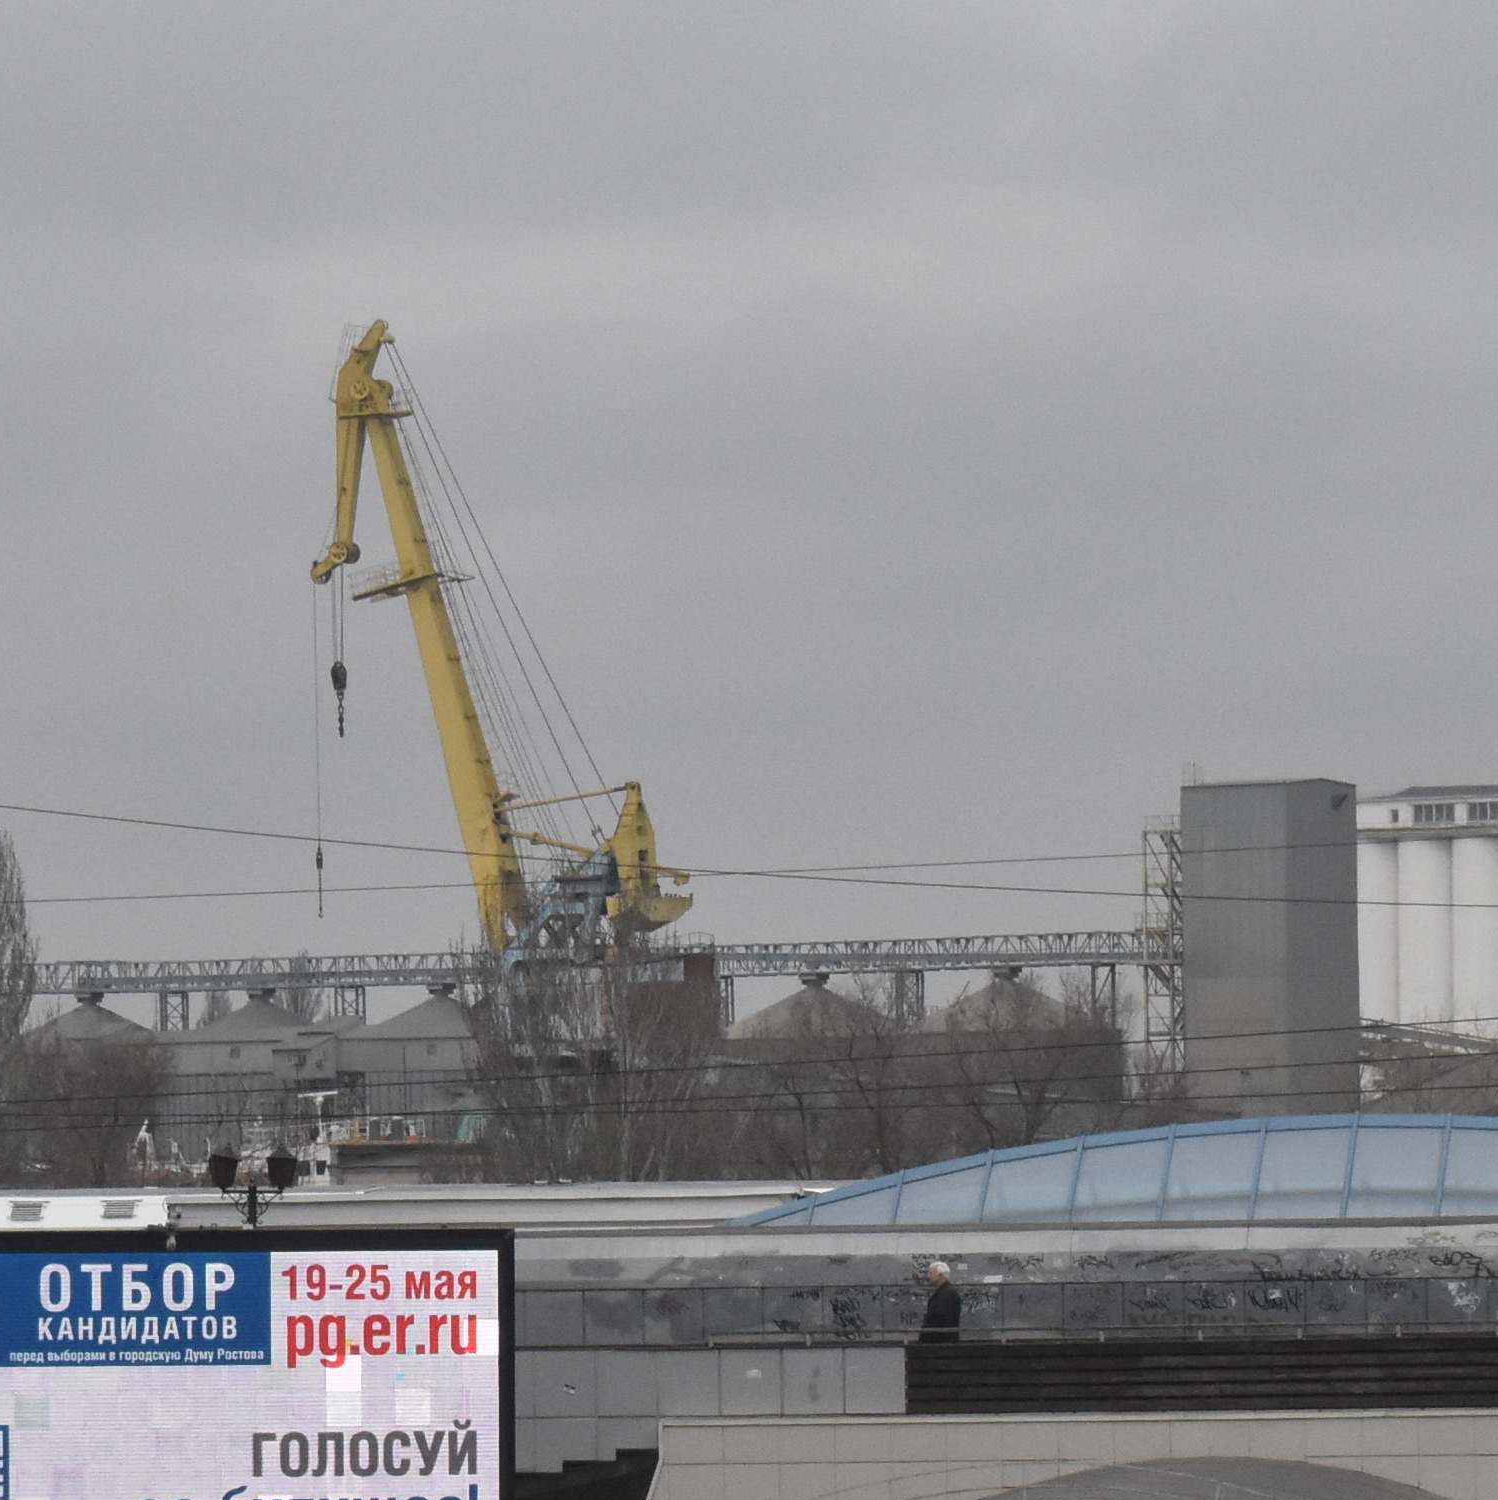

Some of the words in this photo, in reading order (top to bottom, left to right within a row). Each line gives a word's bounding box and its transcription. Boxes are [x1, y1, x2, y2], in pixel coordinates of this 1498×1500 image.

[39, 1262, 235, 1312] ОТБОР
[281, 1264, 391, 1301] 19-25
[405, 1270, 477, 1300] мая
[38, 1316, 238, 1344] КАНДИДАТОВ
[286, 1314, 477, 1368] pg.er.ru
[9, 1351, 44, 1364] перед
[47, 1348, 106, 1362] выборами
[108, 1351, 116, 1361] в
[119, 1350, 181, 1363] городскую
[184, 1348, 214, 1362] Думу
[217, 1348, 264, 1361] Ростова
[251, 1419, 478, 1477] ГОЛОСУЙ
